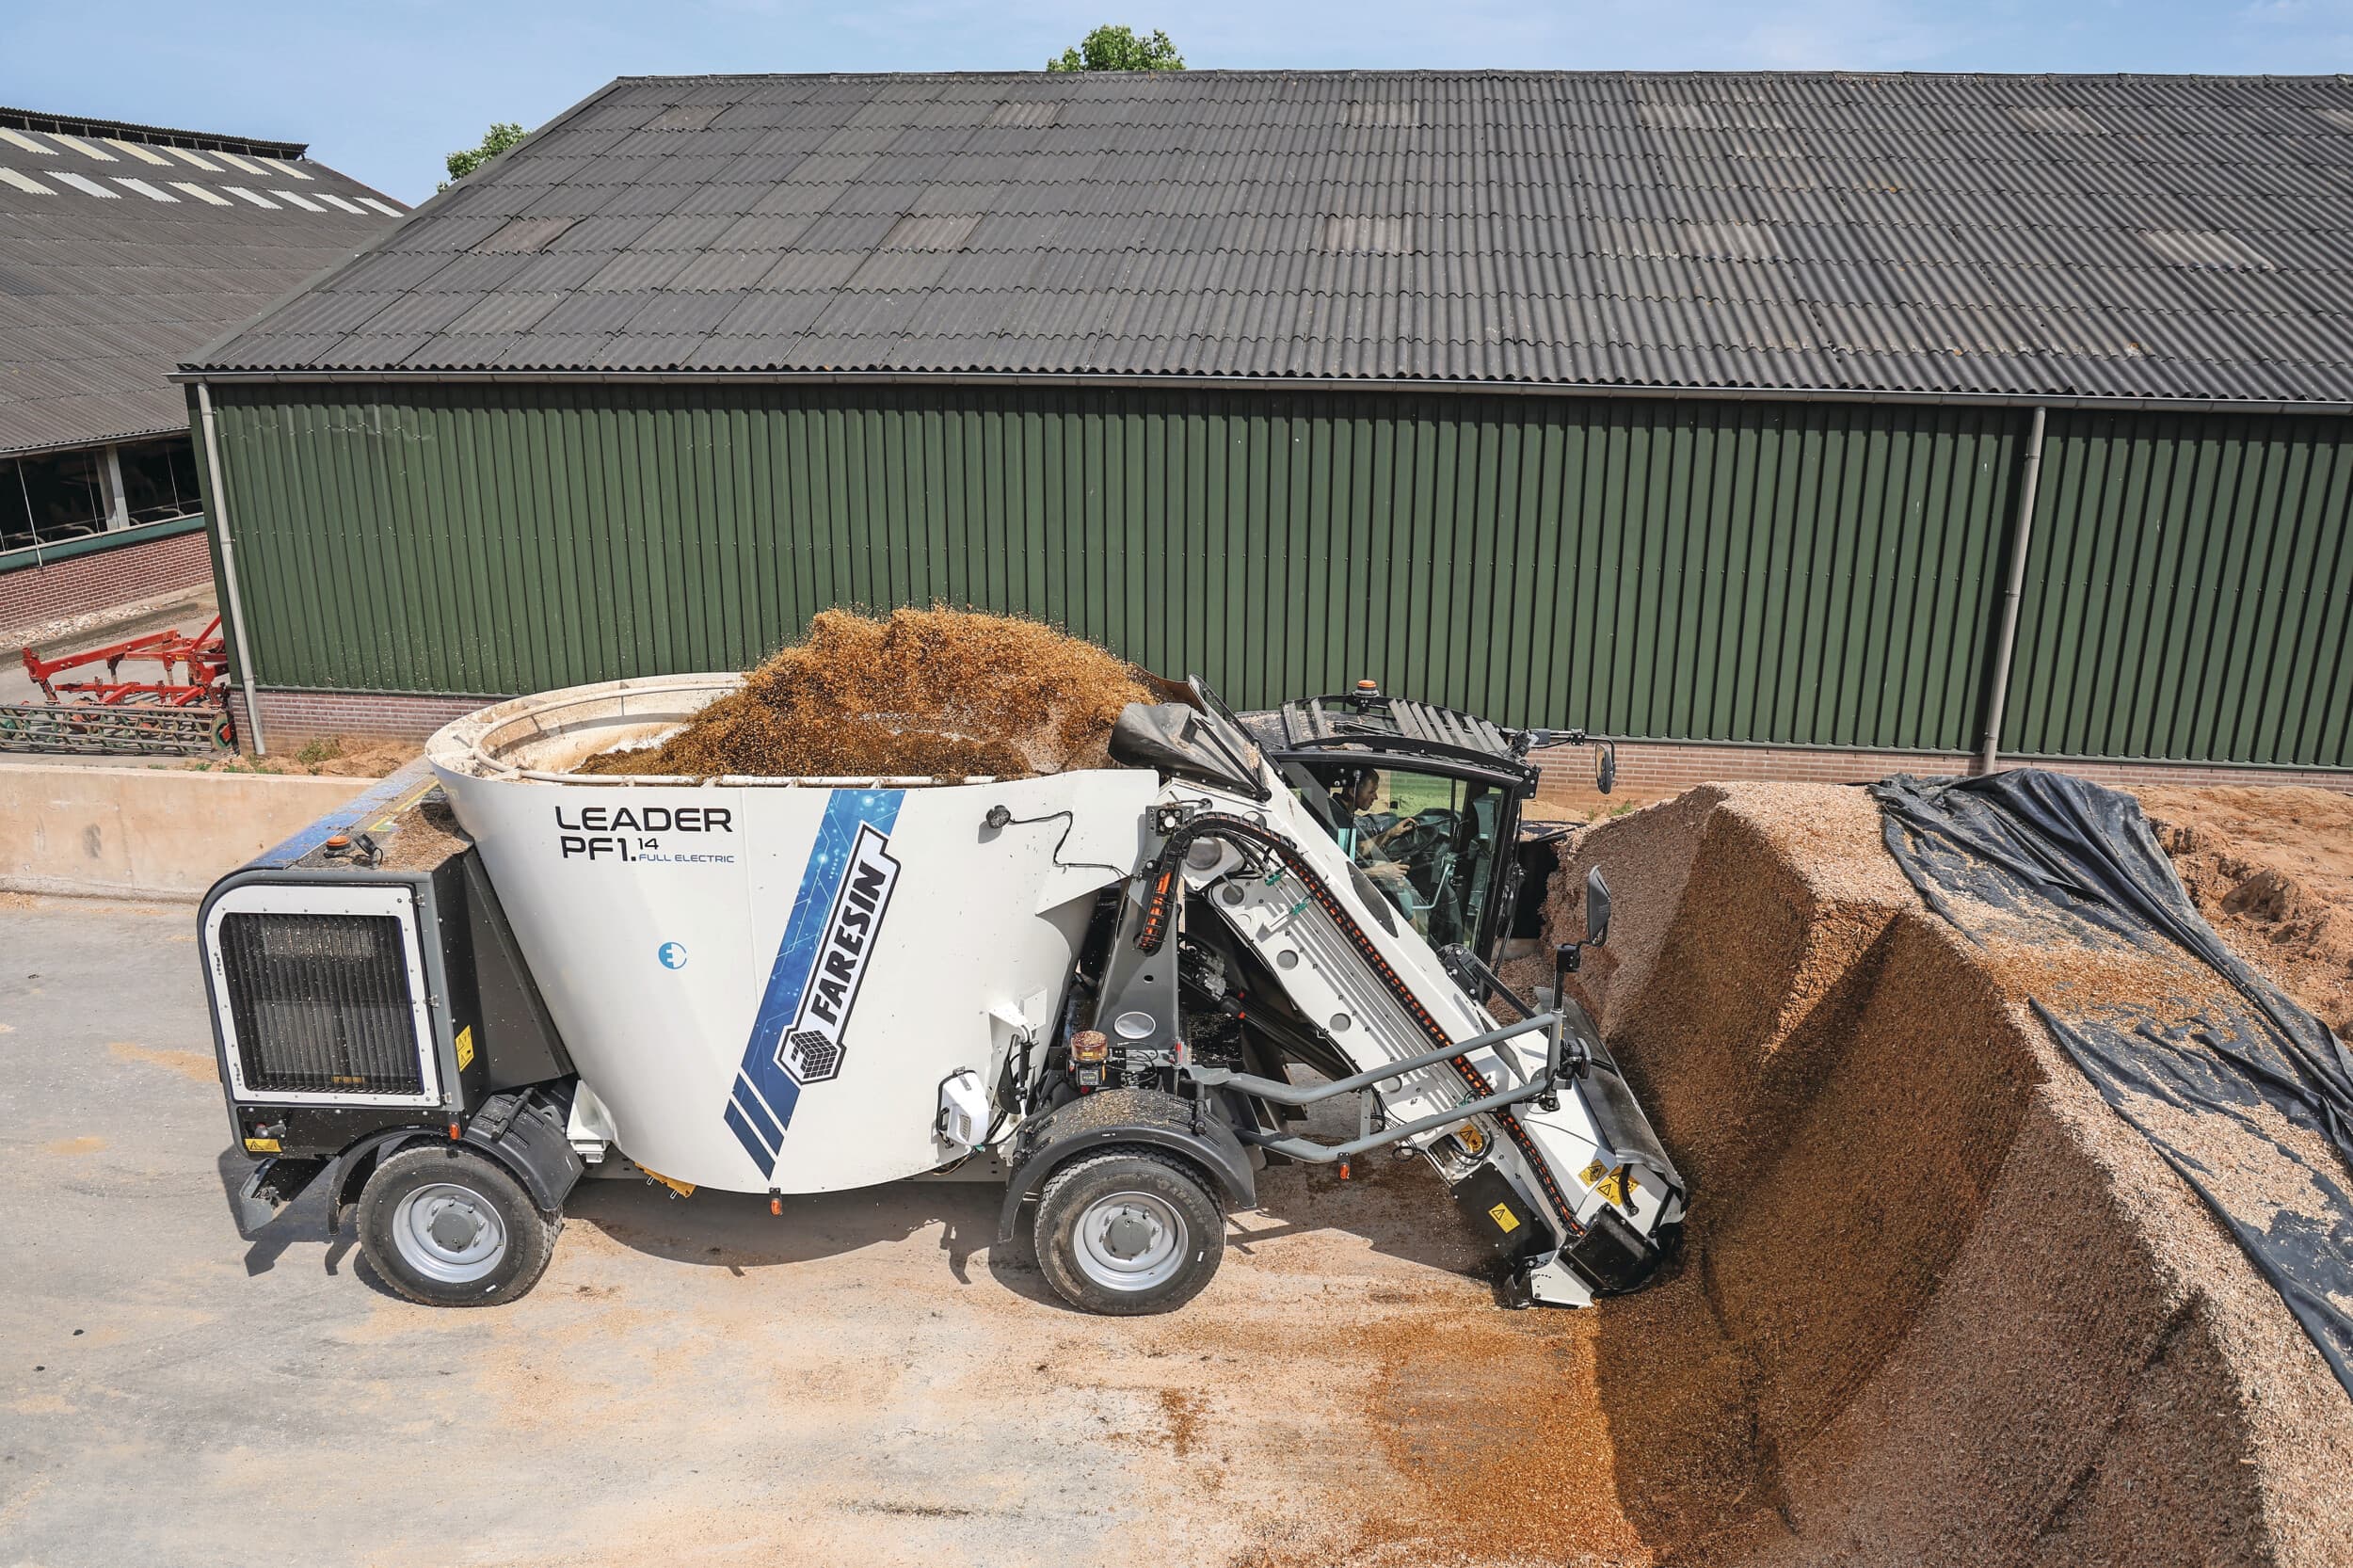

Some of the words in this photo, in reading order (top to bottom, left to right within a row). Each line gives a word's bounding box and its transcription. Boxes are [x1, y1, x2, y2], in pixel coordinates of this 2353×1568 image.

[555, 806, 733, 833] LEADER
[638, 854, 672, 862] FULL
[674, 855, 735, 863] ELECTRIC
[810, 859, 887, 1027] FARESIN
